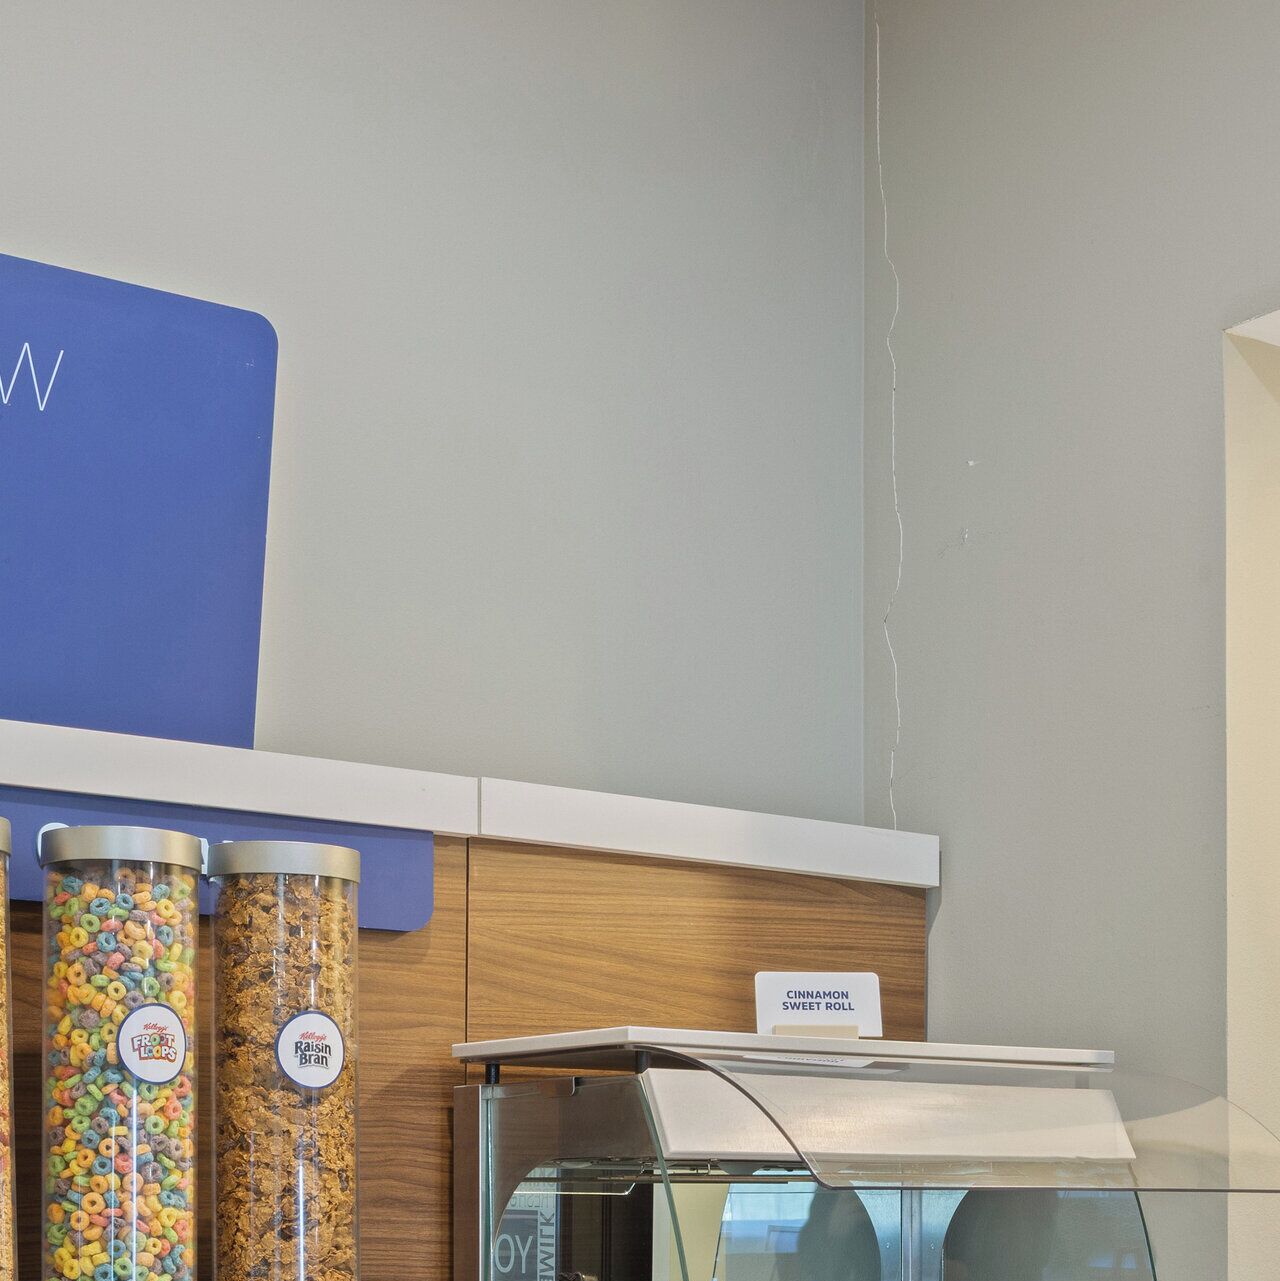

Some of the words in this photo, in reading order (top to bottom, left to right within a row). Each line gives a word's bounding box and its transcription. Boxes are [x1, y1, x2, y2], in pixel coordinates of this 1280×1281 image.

[786, 990, 849, 1000] CINNAMON
[782, 1001, 822, 1011] SWEET
[825, 1001, 855, 1011] ROLL
[131, 1033, 176, 1052] FROOT
[294, 1040, 332, 1057] Raisin
[139, 1045, 177, 1062] LOOPS
[299, 1053, 329, 1068] Bran
